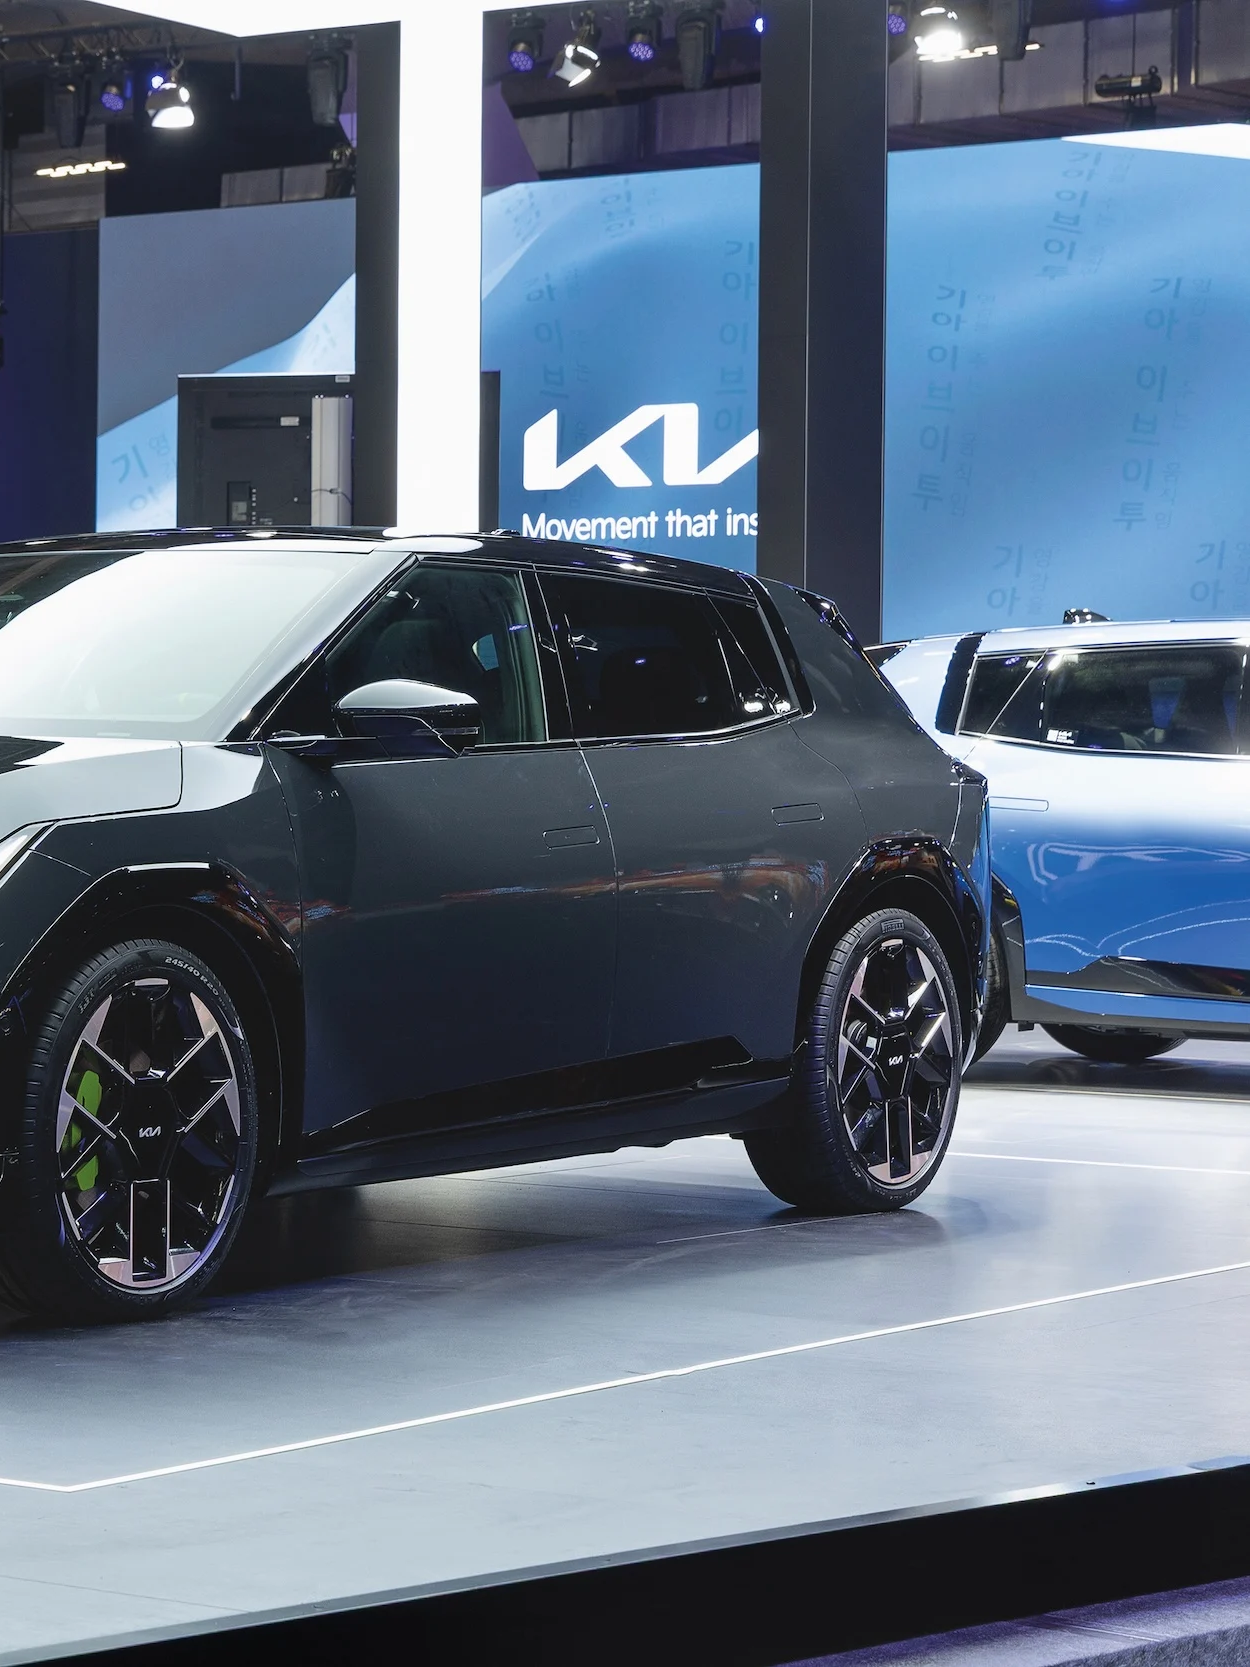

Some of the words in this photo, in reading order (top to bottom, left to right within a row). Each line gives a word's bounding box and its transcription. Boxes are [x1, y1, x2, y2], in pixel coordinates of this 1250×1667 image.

[522, 510, 659, 540] Movement
[664, 507, 719, 538] that
[139, 1125, 161, 1138] KIA
